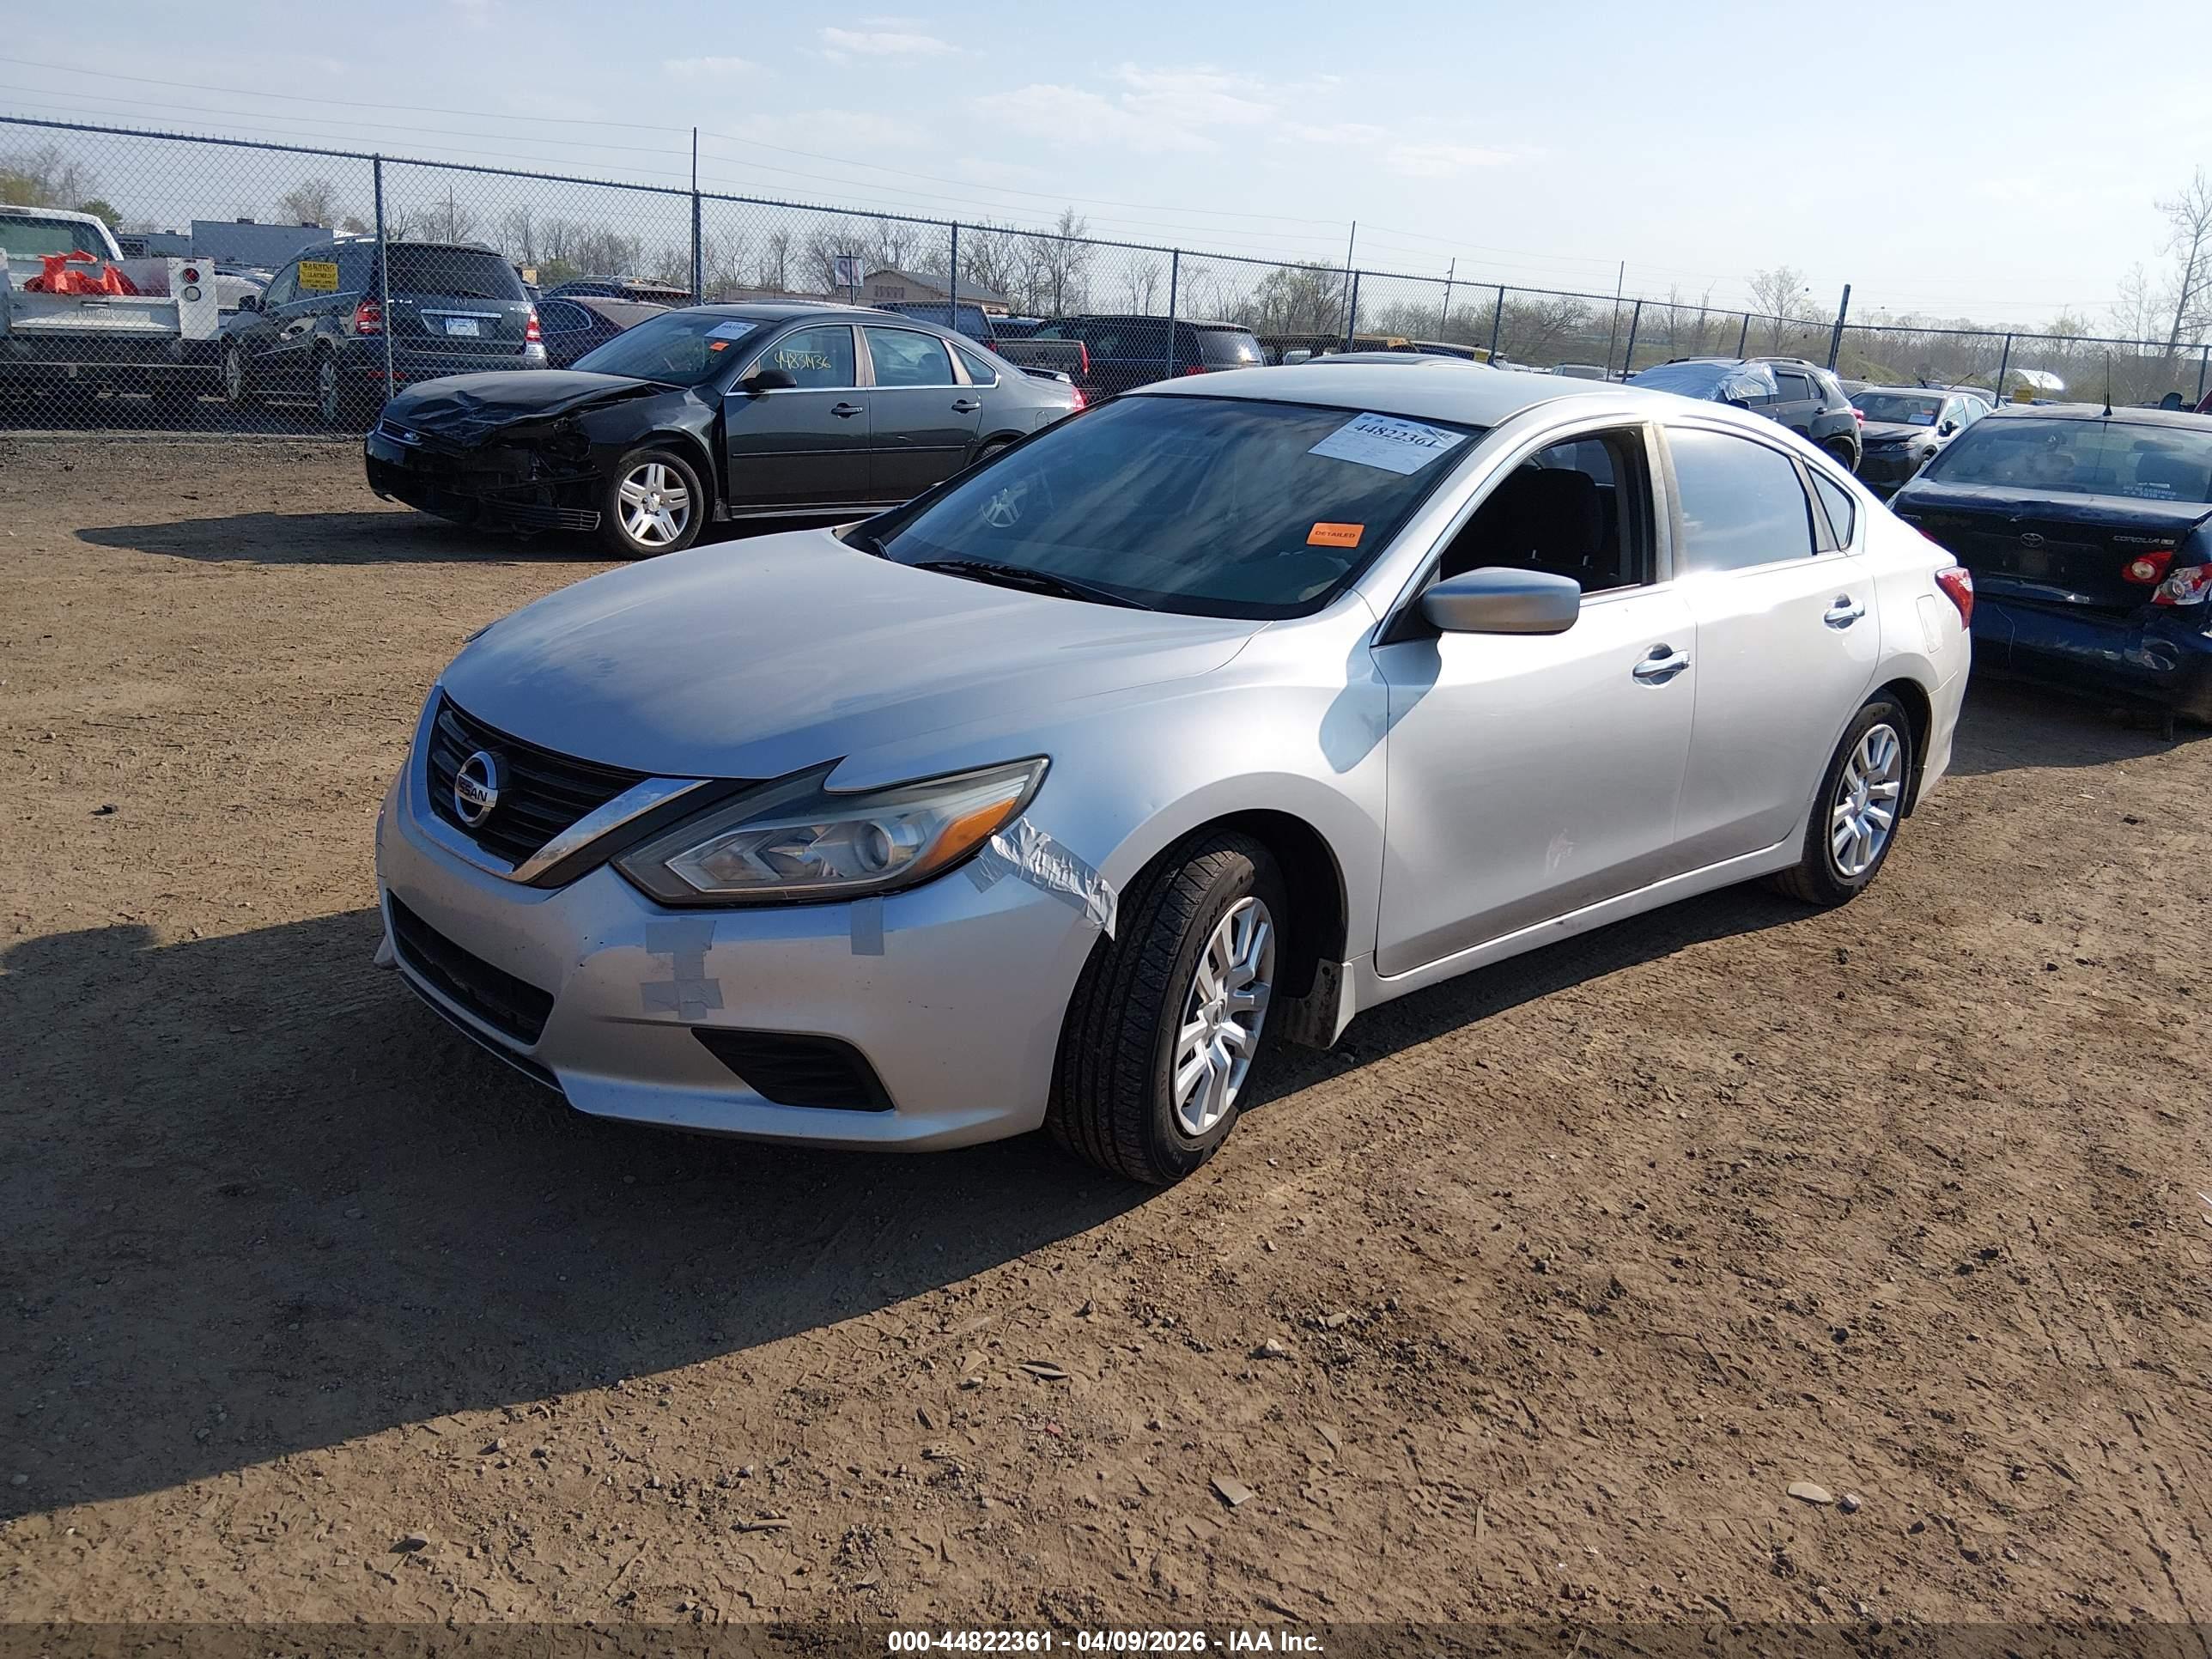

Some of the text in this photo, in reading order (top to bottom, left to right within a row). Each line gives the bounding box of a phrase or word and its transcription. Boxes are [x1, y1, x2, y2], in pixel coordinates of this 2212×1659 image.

[775, 350, 831, 370] 44831436
[1354, 423, 1437, 447] 44822361
[459, 778, 489, 802] SSAN
